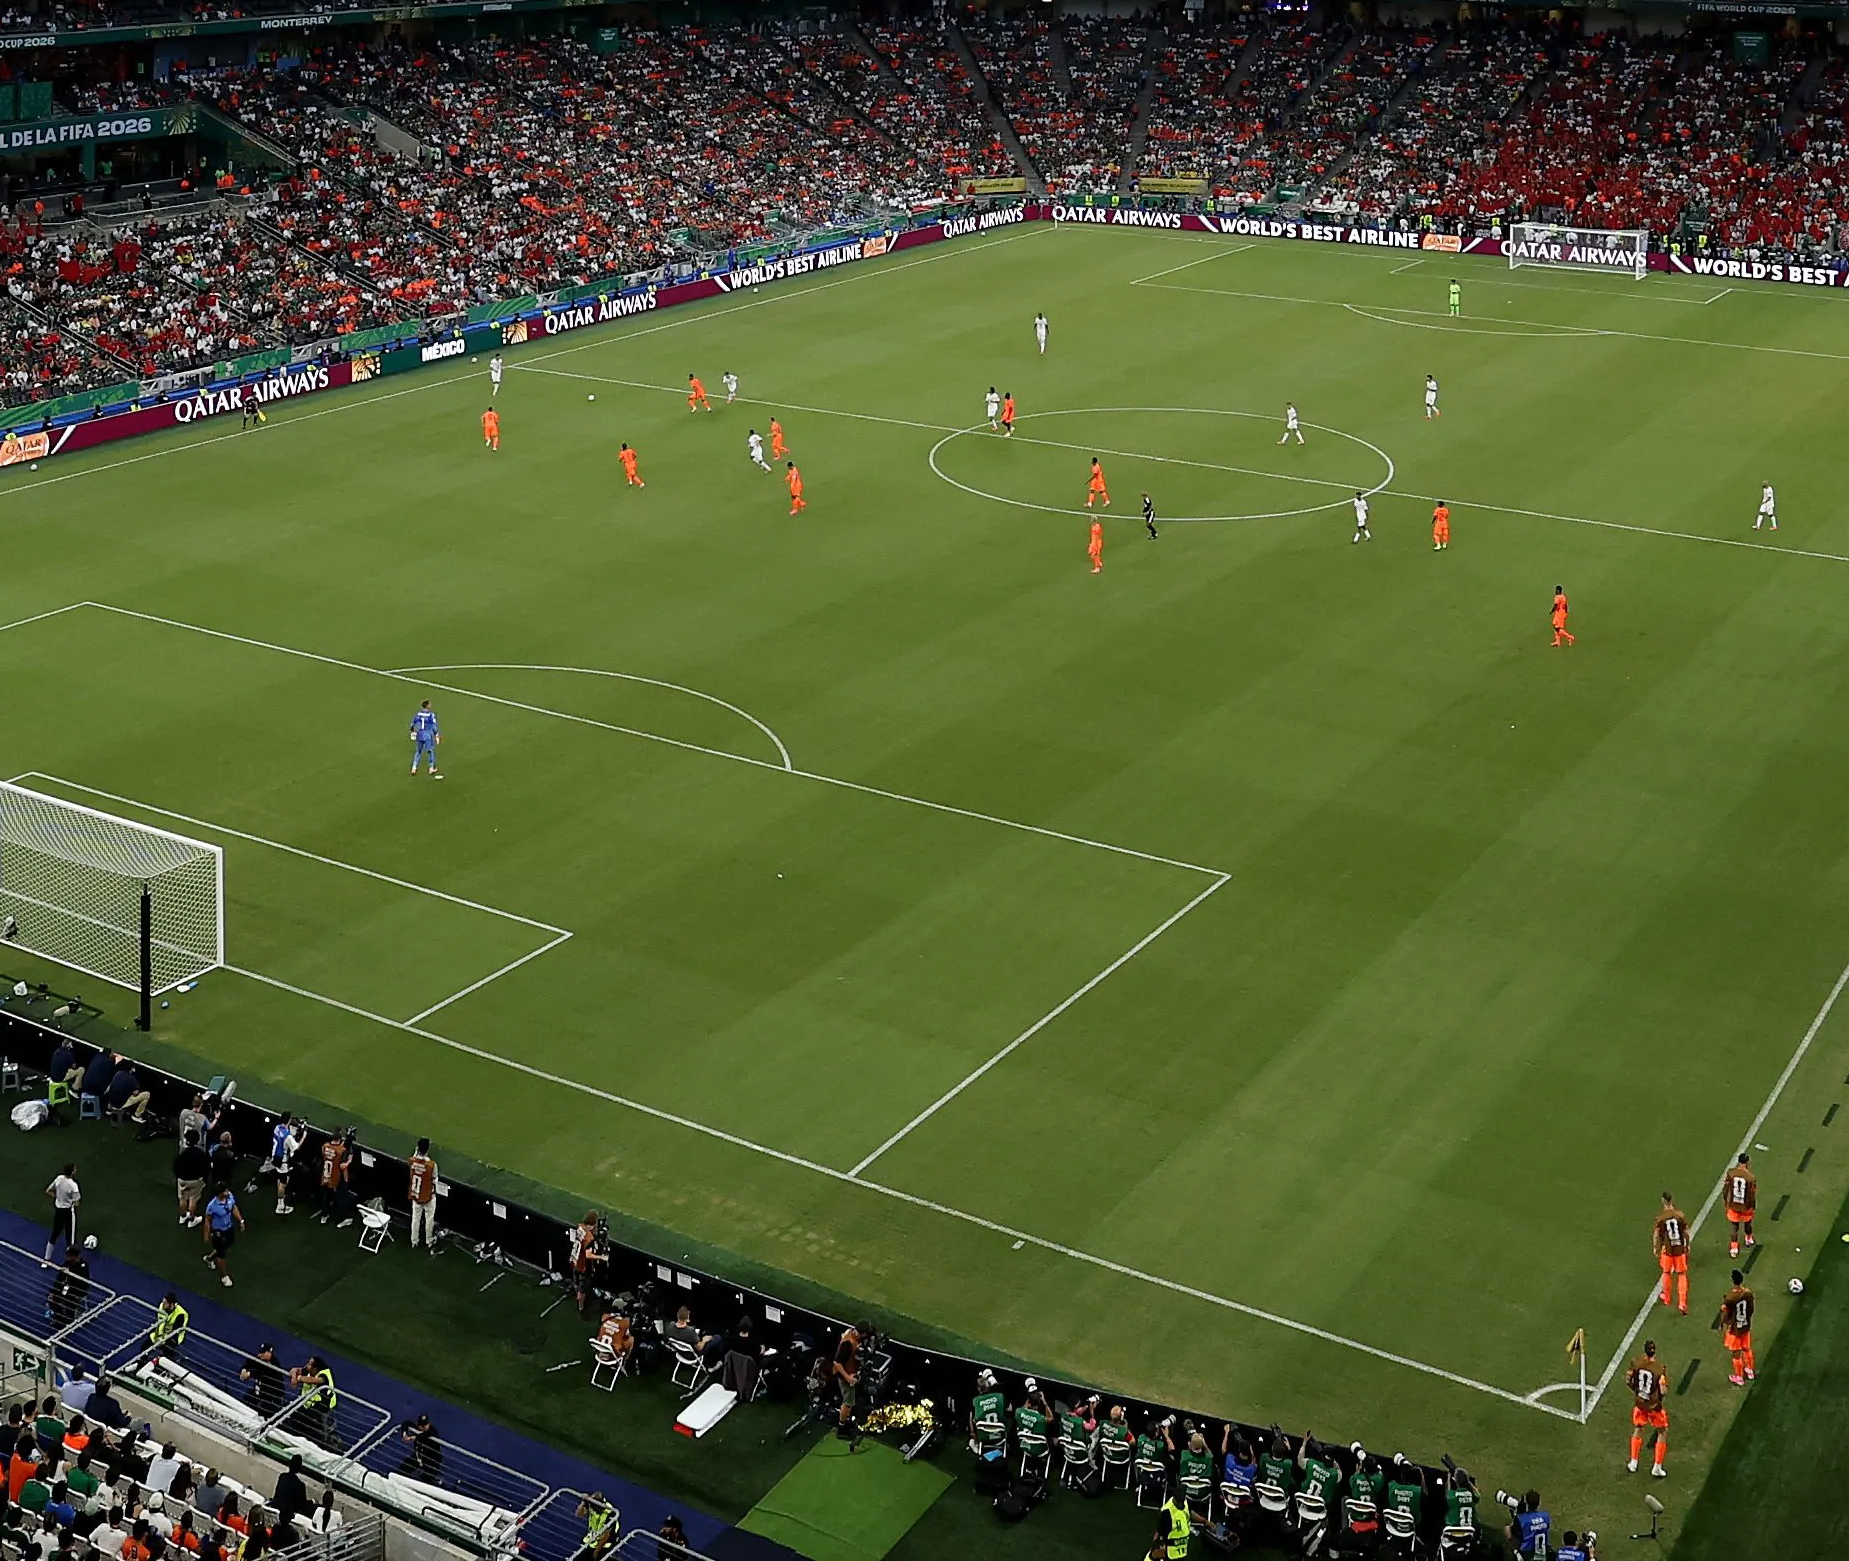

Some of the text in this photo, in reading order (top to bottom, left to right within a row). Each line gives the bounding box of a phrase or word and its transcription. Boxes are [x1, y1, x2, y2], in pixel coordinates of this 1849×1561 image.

[261, 15, 333, 28] MONTERREY
[5, 39, 23, 50] CUP
[24, 37, 56, 49] 2026
[10, 130, 31, 148] DE
[33, 128, 55, 145] LA
[57, 124, 94, 143] FIFA
[97, 117, 151, 138] 2026
[943, 208, 1023, 238] QATAR AIRWAYS
[1052, 205, 1181, 229] QATAR AIRWAYS
[1219, 218, 1419, 248] WORLD'S BEST AIRLINE
[730, 244, 861, 288] WORLD'S BEST AIRLINE
[1501, 241, 1647, 267] QATAR AIRWAYS
[1694, 257, 1783, 282] WORLD'S
[1788, 265, 1838, 287] BEST
[545, 292, 657, 335] QATAR AIRWAYS
[421, 339, 465, 362] MÉXICO
[174, 367, 329, 423] QATAR AIRWAYS
[6, 439, 41, 455] QATAR
[421, 717, 425, 730] 1
